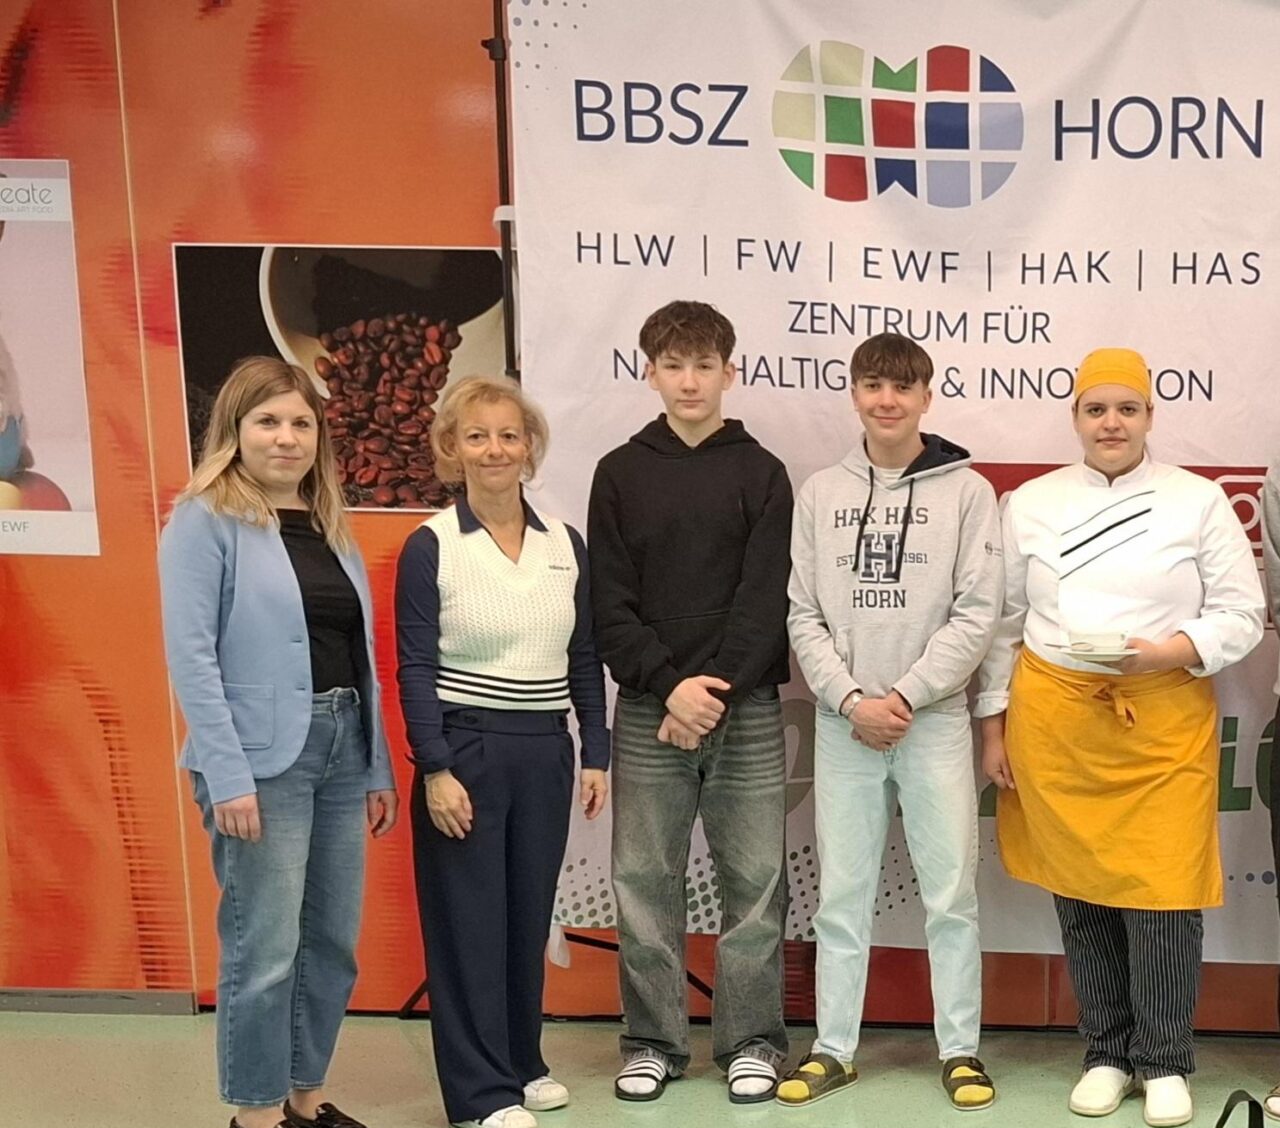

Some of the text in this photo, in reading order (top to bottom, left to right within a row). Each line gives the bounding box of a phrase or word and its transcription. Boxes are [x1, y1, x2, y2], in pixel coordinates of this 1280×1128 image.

[574, 79, 1264, 161] BBSZ HORN
[0, 182, 52, 204] eate
[577, 231, 675, 267] HLW
[737, 238, 802, 273] FW
[863, 246, 960, 284] EWF
[1021, 251, 1112, 285] HAK
[1172, 251, 1262, 285] HAS
[788, 300, 1052, 344] ZENTRUM FÜR
[940, 366, 967, 399] &
[1, 521, 30, 533] EWF
[834, 507, 877, 528] HAK
[903, 552, 929, 565] 1961
[852, 589, 907, 609] HORN
